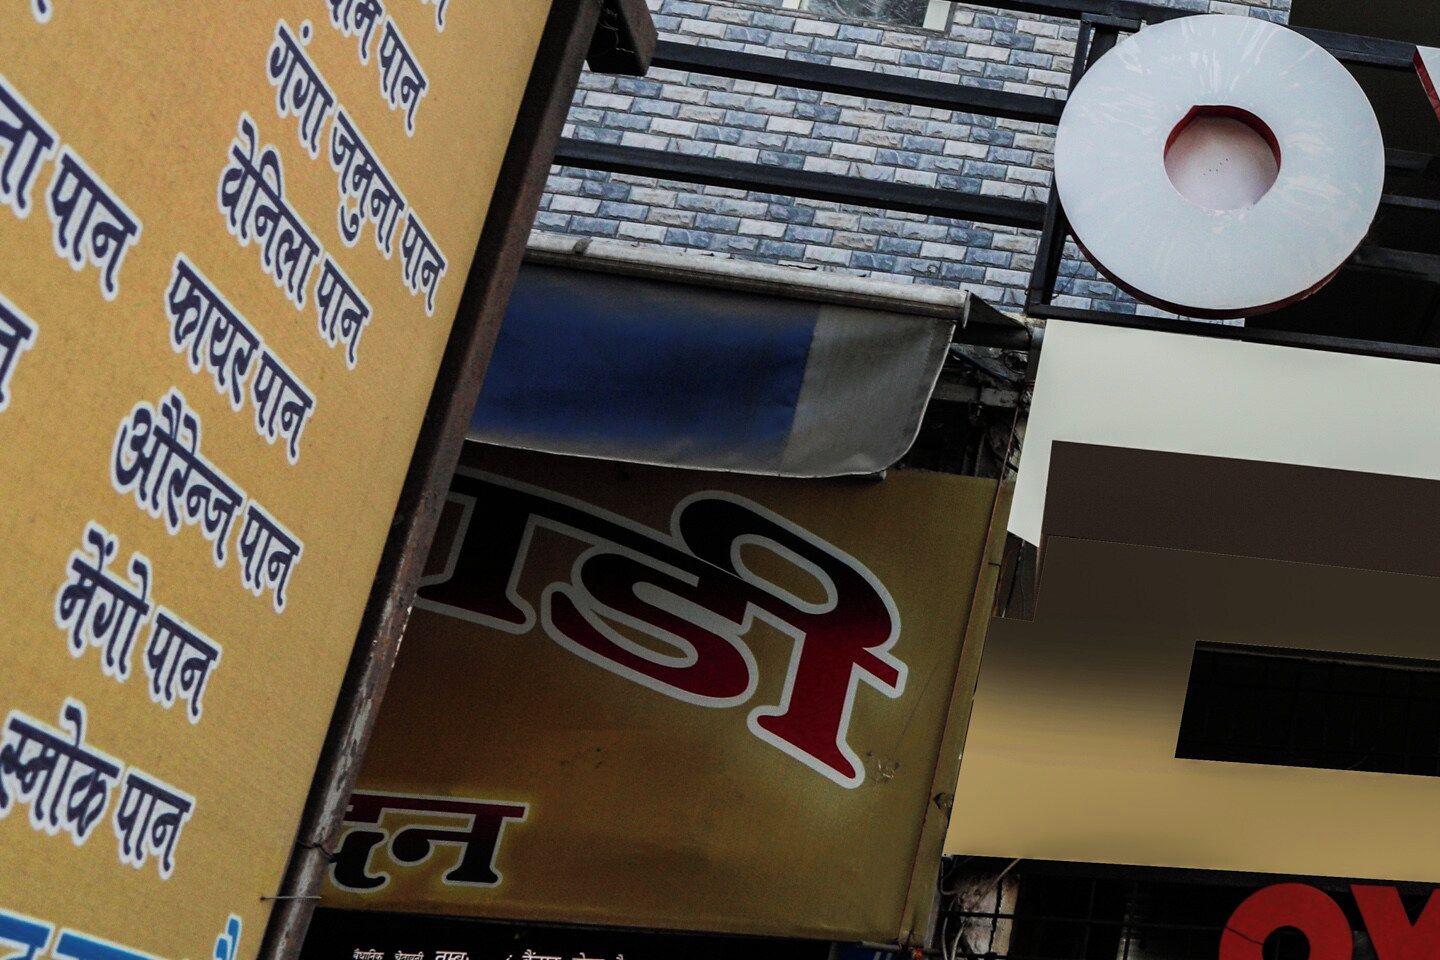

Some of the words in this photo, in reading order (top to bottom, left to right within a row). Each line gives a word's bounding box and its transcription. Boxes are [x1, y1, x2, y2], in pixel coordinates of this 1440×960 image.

[379, 21, 427, 131] पान
[51, 152, 138, 293] पान
[270, 25, 334, 153] गंगा
[332, 110, 405, 254] जमुना
[402, 213, 445, 312] पान
[168, 260, 260, 404] फायर
[253, 350, 313, 458] पान
[317, 258, 370, 364] पान
[240, 505, 301, 607] पान
[147, 612, 219, 717] पान
[415, 472, 904, 782] ाडी
[117, 773, 192, 872] पान
